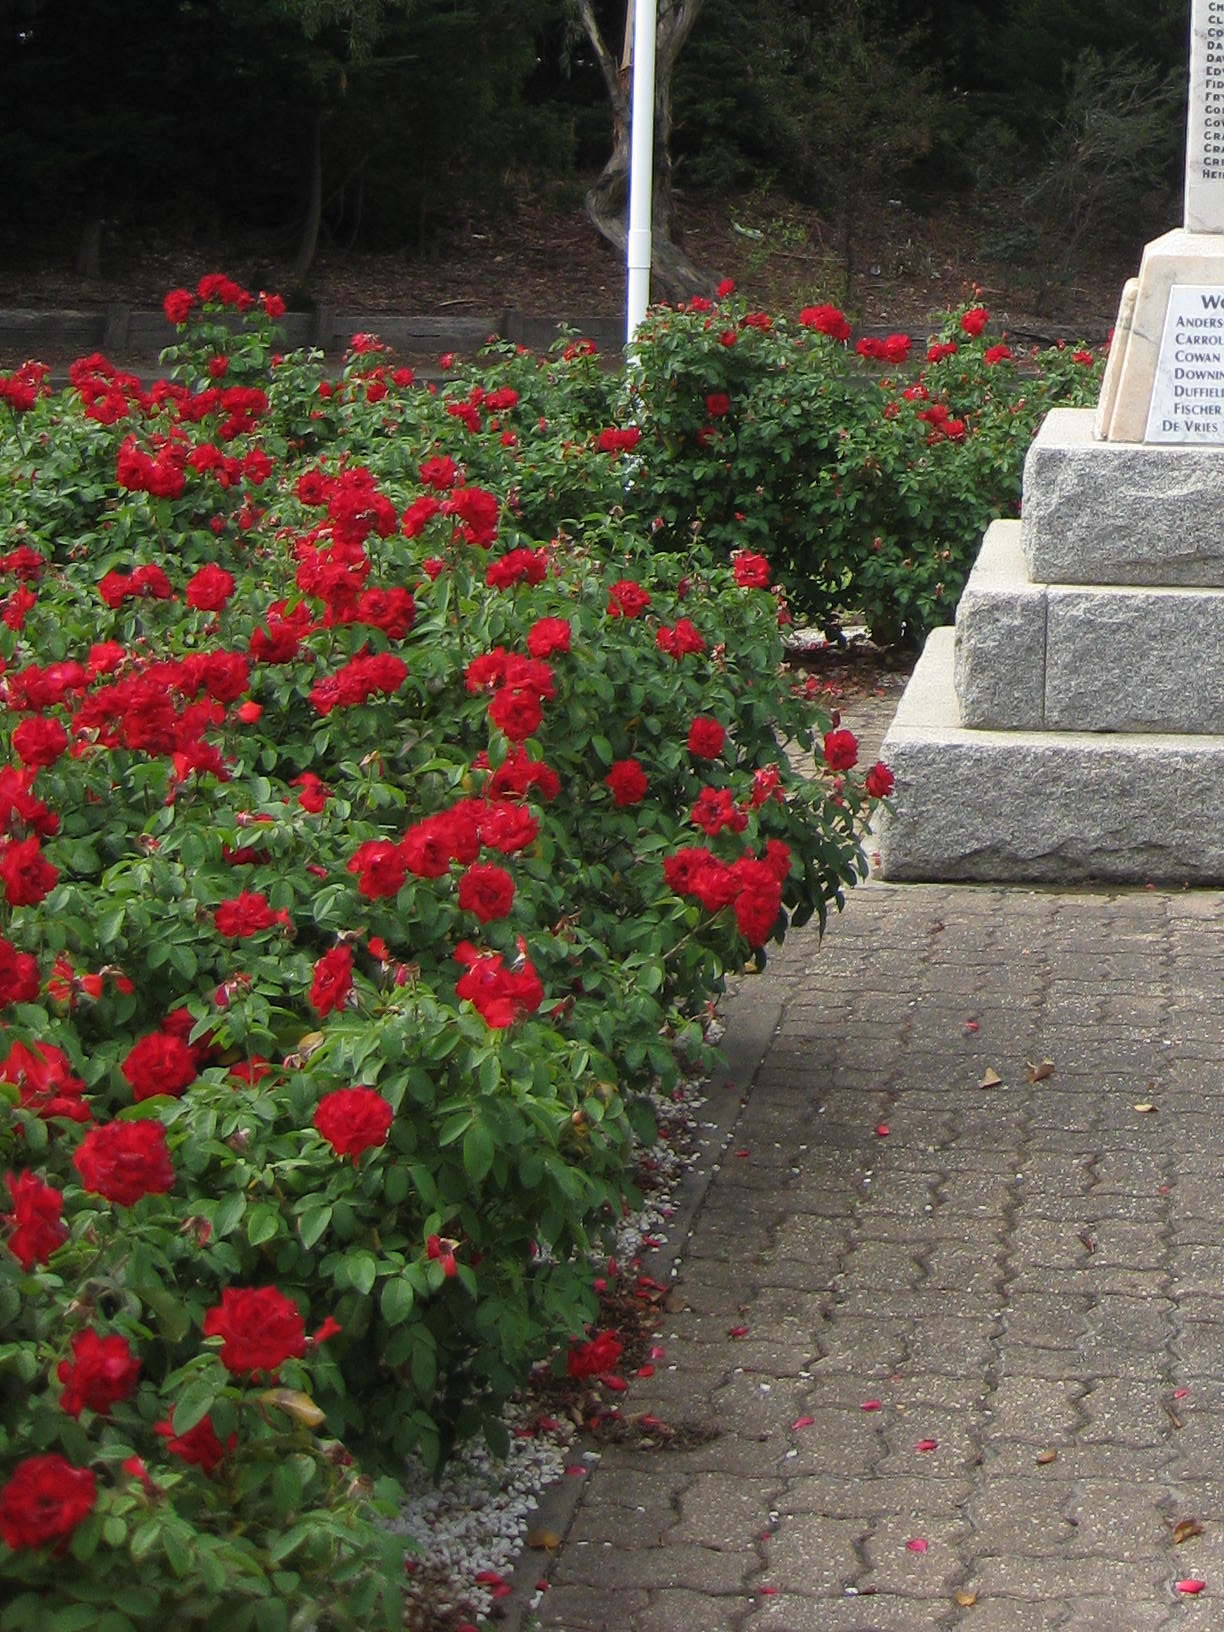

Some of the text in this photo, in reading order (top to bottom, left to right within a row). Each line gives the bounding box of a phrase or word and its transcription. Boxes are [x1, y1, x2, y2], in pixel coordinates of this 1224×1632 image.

[1174, 350, 1221, 363] COWAN
[1174, 403, 1222, 416] FISCHER
[1162, 419, 1180, 433] DE
[1184, 420, 1218, 433] VRIES
